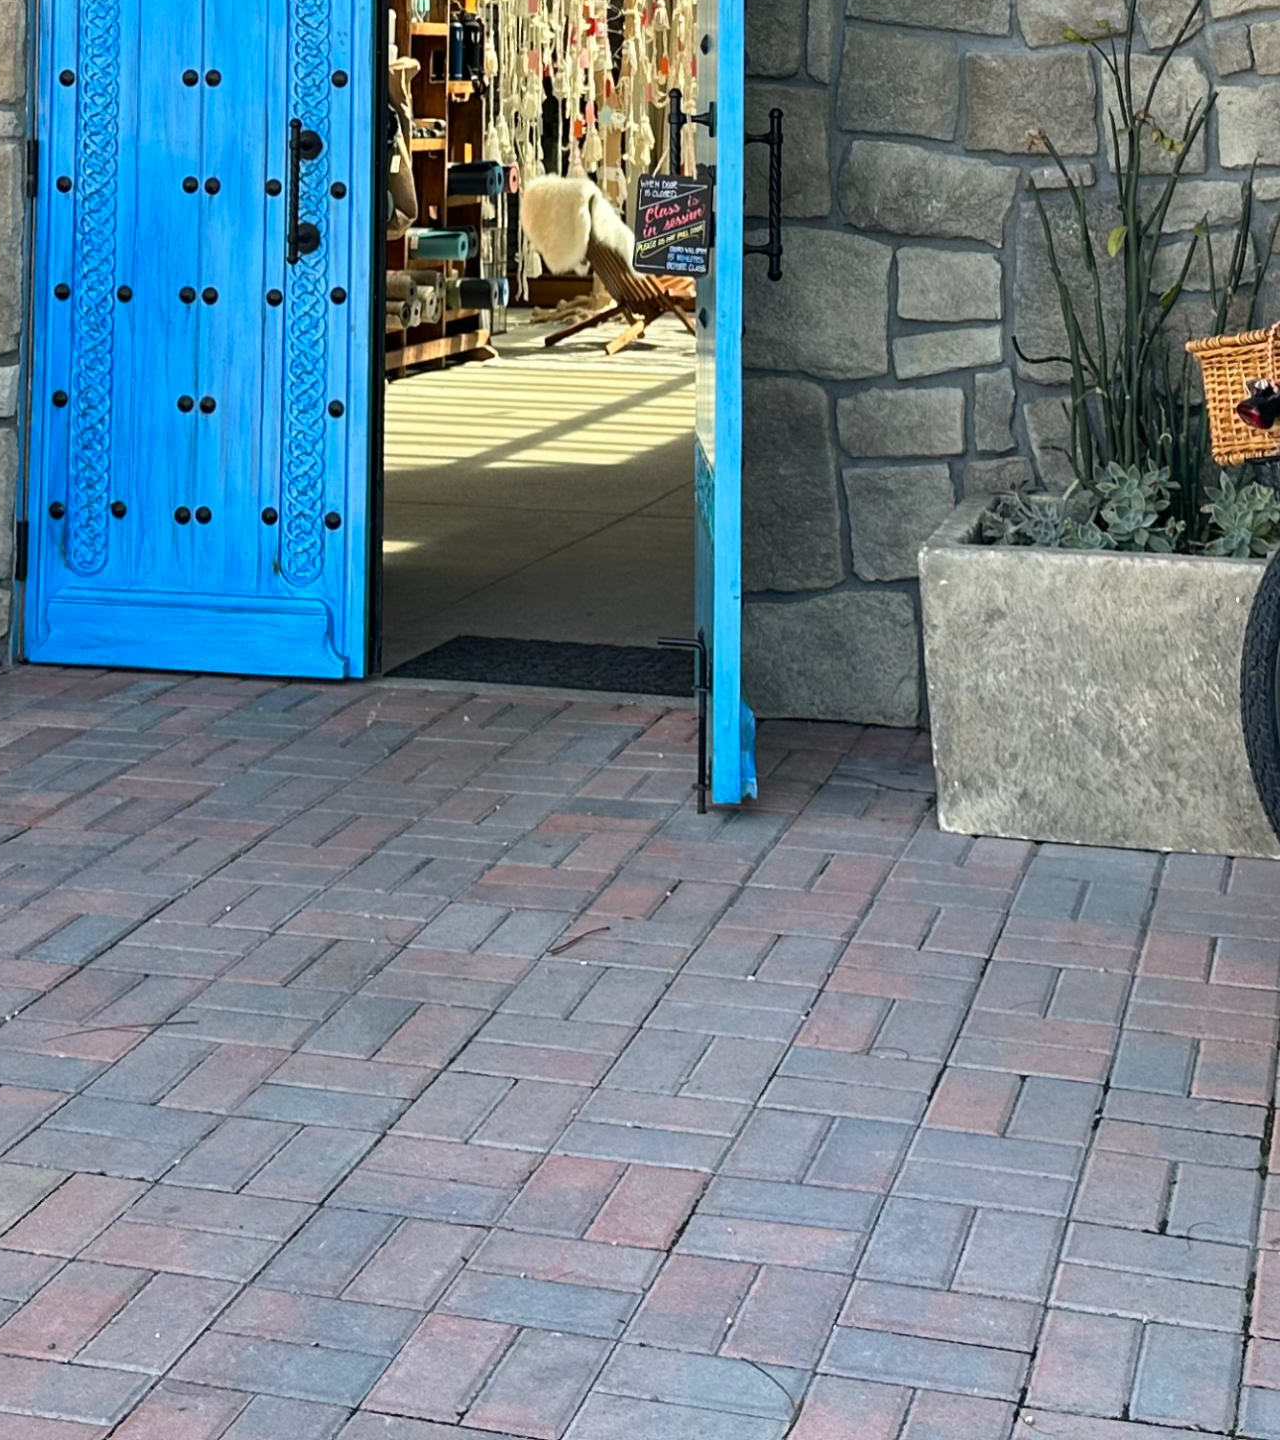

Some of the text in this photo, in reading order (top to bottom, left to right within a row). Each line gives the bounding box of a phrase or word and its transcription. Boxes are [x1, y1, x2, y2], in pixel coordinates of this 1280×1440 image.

[640, 180, 660, 189] WHEN
[642, 203, 706, 238] in session
[645, 195, 700, 223] Class is
